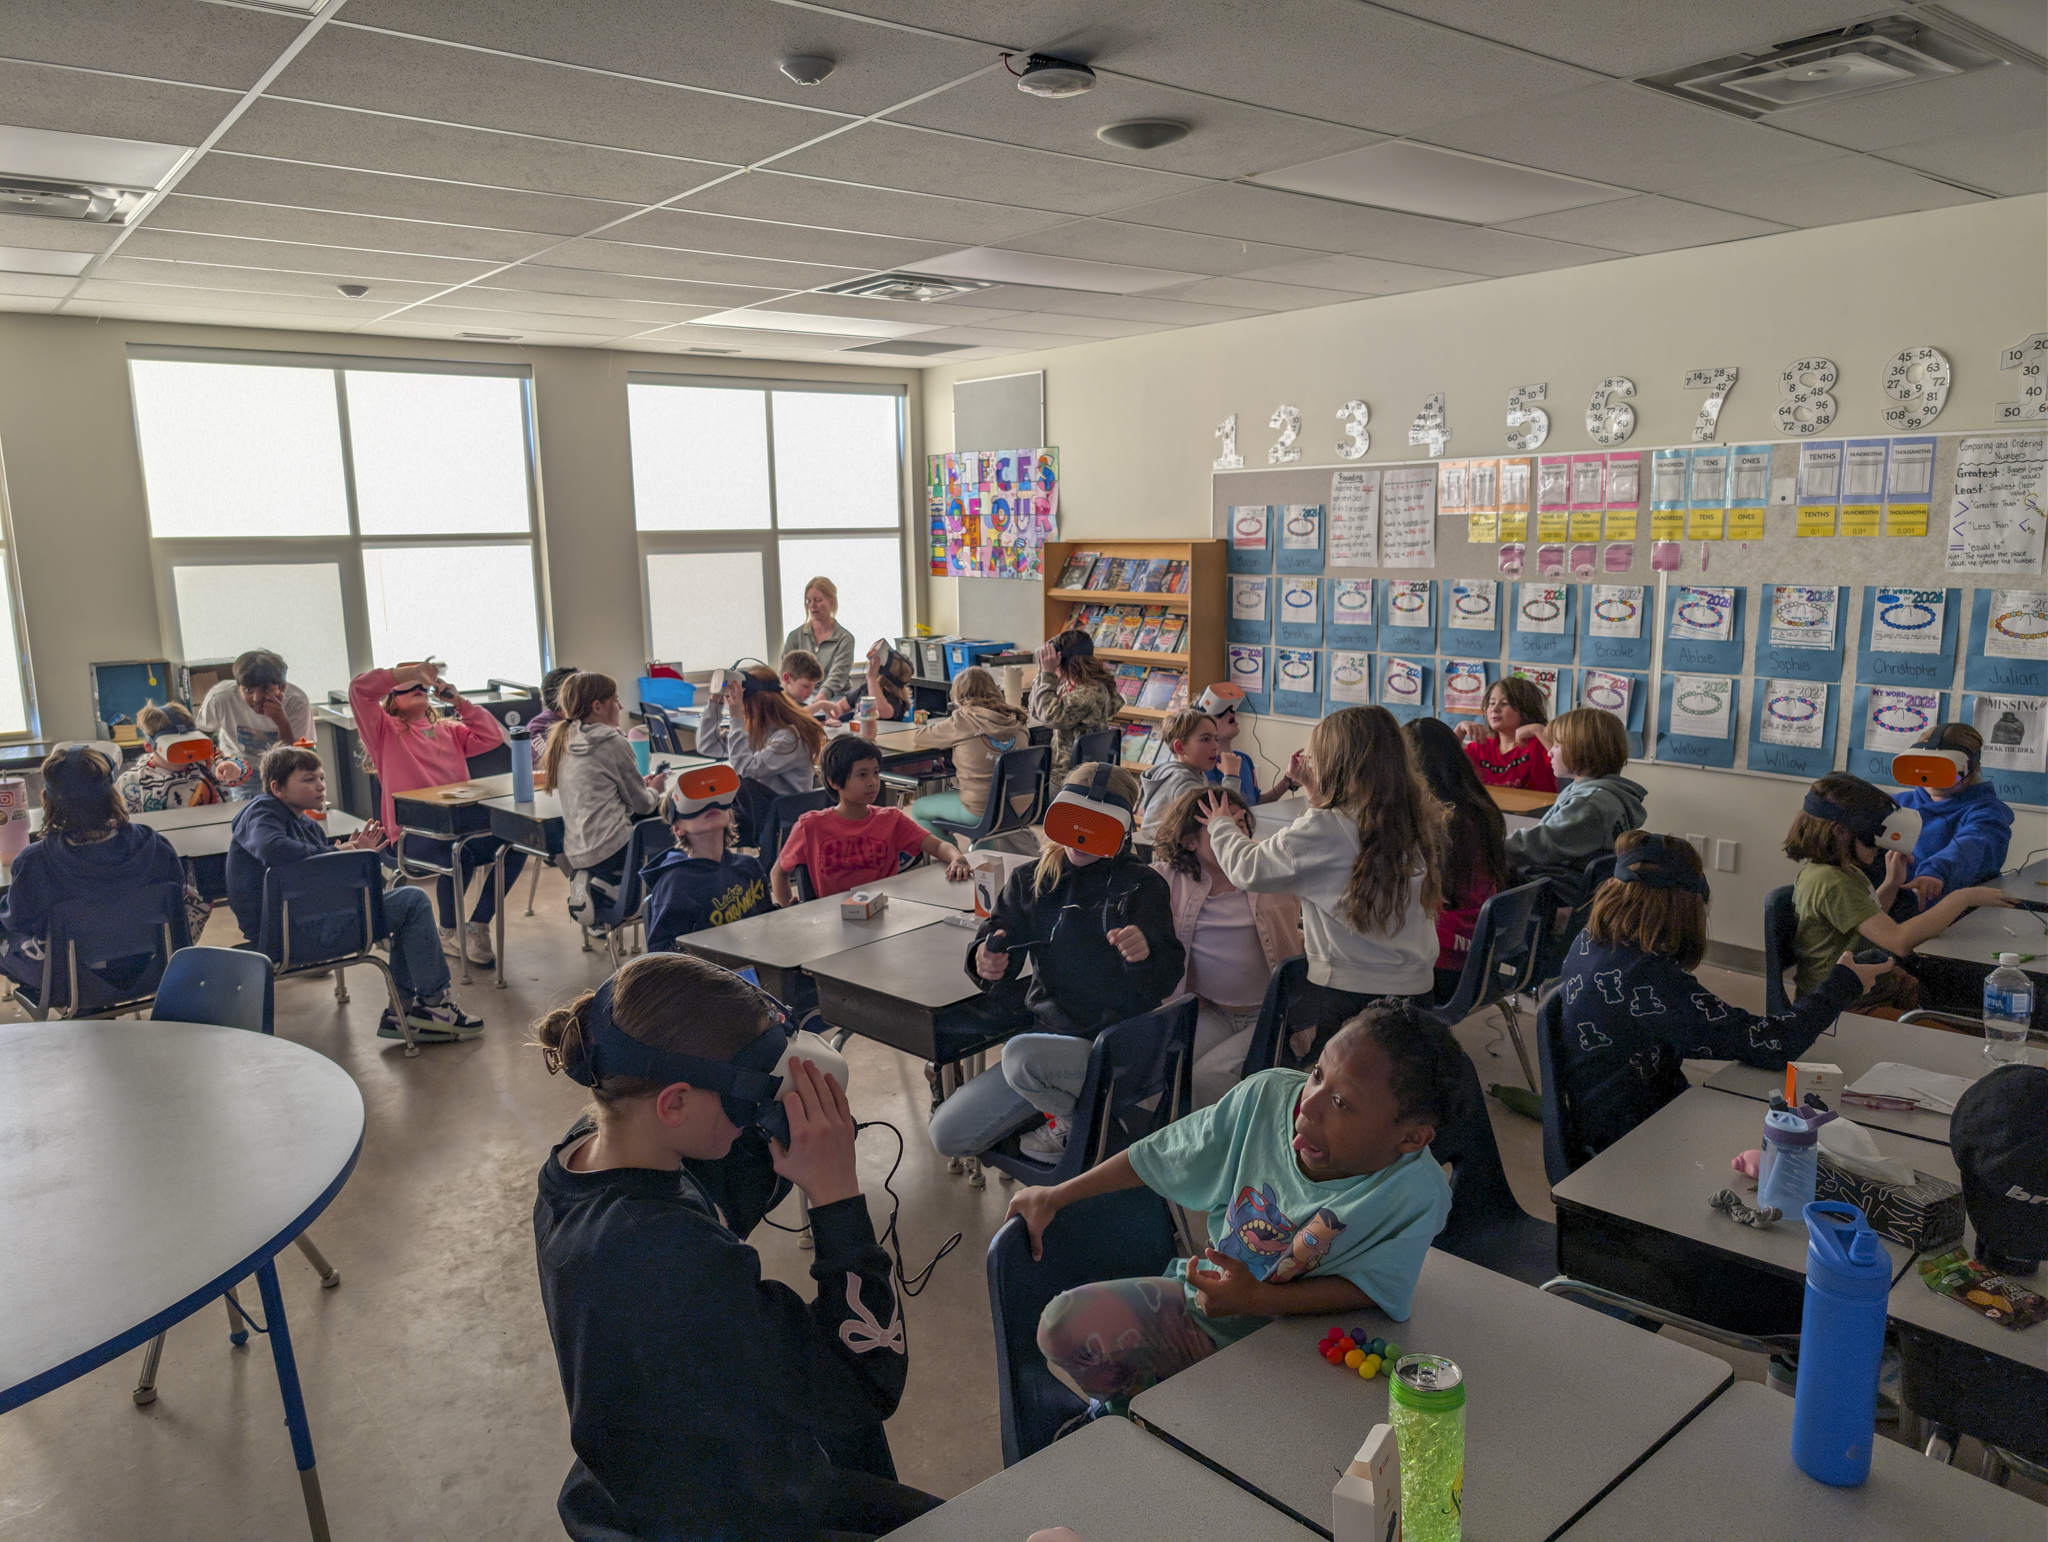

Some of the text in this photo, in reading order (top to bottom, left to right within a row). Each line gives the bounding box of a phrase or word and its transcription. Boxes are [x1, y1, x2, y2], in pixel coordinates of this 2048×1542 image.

[1898, 352, 1912, 362] 45
[1919, 349, 1932, 359] 54
[2009, 350, 2023, 360] 10
[1797, 362, 1810, 370] 24
[1814, 361, 1827, 370] 32
[1926, 363, 1940, 372] 63
[1714, 369, 1724, 377] 28
[1891, 366, 1905, 376] 36
[2023, 365, 2040, 376] 30
[1693, 372, 1702, 380] 14
[1703, 376, 1711, 384] 21
[1725, 374, 1735, 382] 35
[1782, 372, 1793, 380] 16
[1820, 373, 1834, 382] 40
[1686, 378, 1691, 386] 7
[1887, 380, 1900, 389] 27
[1933, 377, 1945, 386] 72
[1715, 383, 1726, 391] 42
[1789, 384, 1796, 392] 8
[1810, 387, 1823, 396] 48
[1915, 384, 1922, 392] 9
[2026, 386, 2042, 396] 40
[1709, 392, 1719, 400] 49
[1794, 394, 1806, 403] 56
[1899, 390, 1911, 399] 18
[1926, 392, 1938, 401] 81
[1815, 401, 1828, 409] 96
[1778, 407, 1792, 416] 64
[1922, 406, 1938, 415] 90
[2004, 407, 2020, 417] 50
[1816, 416, 1829, 424] 88
[1886, 411, 1905, 421] 108
[1783, 422, 1794, 431] 72
[1907, 419, 1921, 428] 99
[1800, 424, 1814, 433] 80
[1959, 440, 1993, 454] Comparing
[2012, 439, 2043, 451] Ordering
[1995, 452, 2026, 460] Numbers
[948, 454, 1055, 493] PIECES
[2010, 550, 2026, 558] place
[1410, 583, 1429, 592] 2026
[1691, 588, 1708, 596] WORD
[1879, 588, 1913, 596] MY WORD
[1544, 589, 1565, 600] 2026
[1706, 594, 1730, 608] 2026
[1392, 630, 1420, 650] Gabby
[1457, 637, 1482, 651] Miles
[1522, 637, 1557, 656] Bryant
[1595, 642, 1635, 658] Brooke
[1679, 647, 1716, 664] Abbie
[1770, 651, 1811, 674] Sophie
[1873, 658, 1938, 679] Christopher
[1535, 671, 1556, 682] 2026
[1989, 665, 2039, 686] Julian
[1873, 689, 1906, 698] MY WORD
[1905, 694, 1936, 708] 2026
[1987, 698, 2039, 711] MISSING
[1669, 740, 1710, 758] Walker
[2017, 746, 2034, 754] ROCK
[1764, 750, 1806, 772] Willow
[819, 835, 888, 875] GAP
